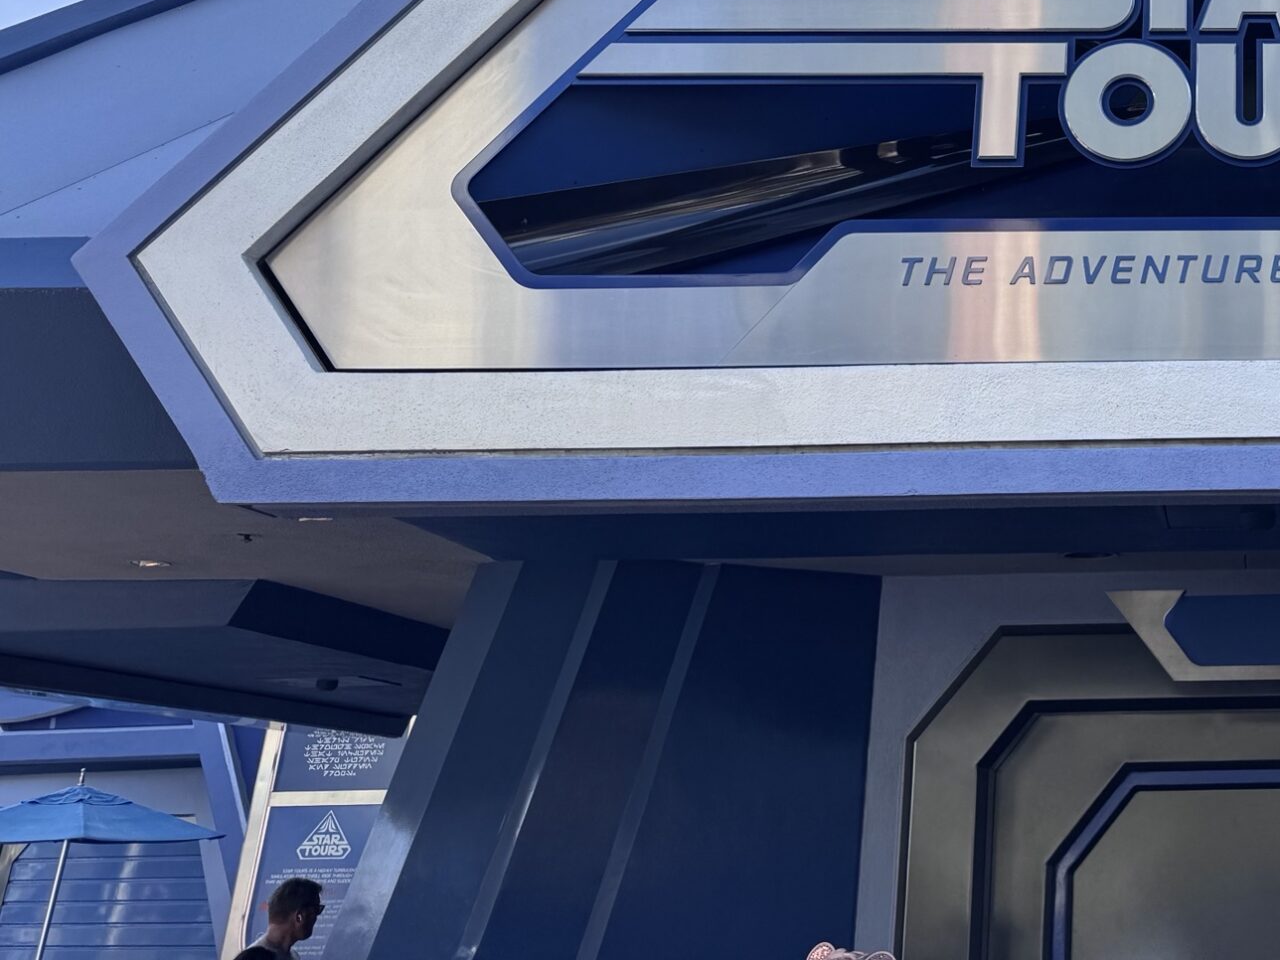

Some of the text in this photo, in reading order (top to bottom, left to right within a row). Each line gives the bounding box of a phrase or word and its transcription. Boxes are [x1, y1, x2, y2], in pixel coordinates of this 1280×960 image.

[901, 255, 988, 287] THE
[308, 834, 344, 845] STAR
[304, 845, 345, 857] TOURS
